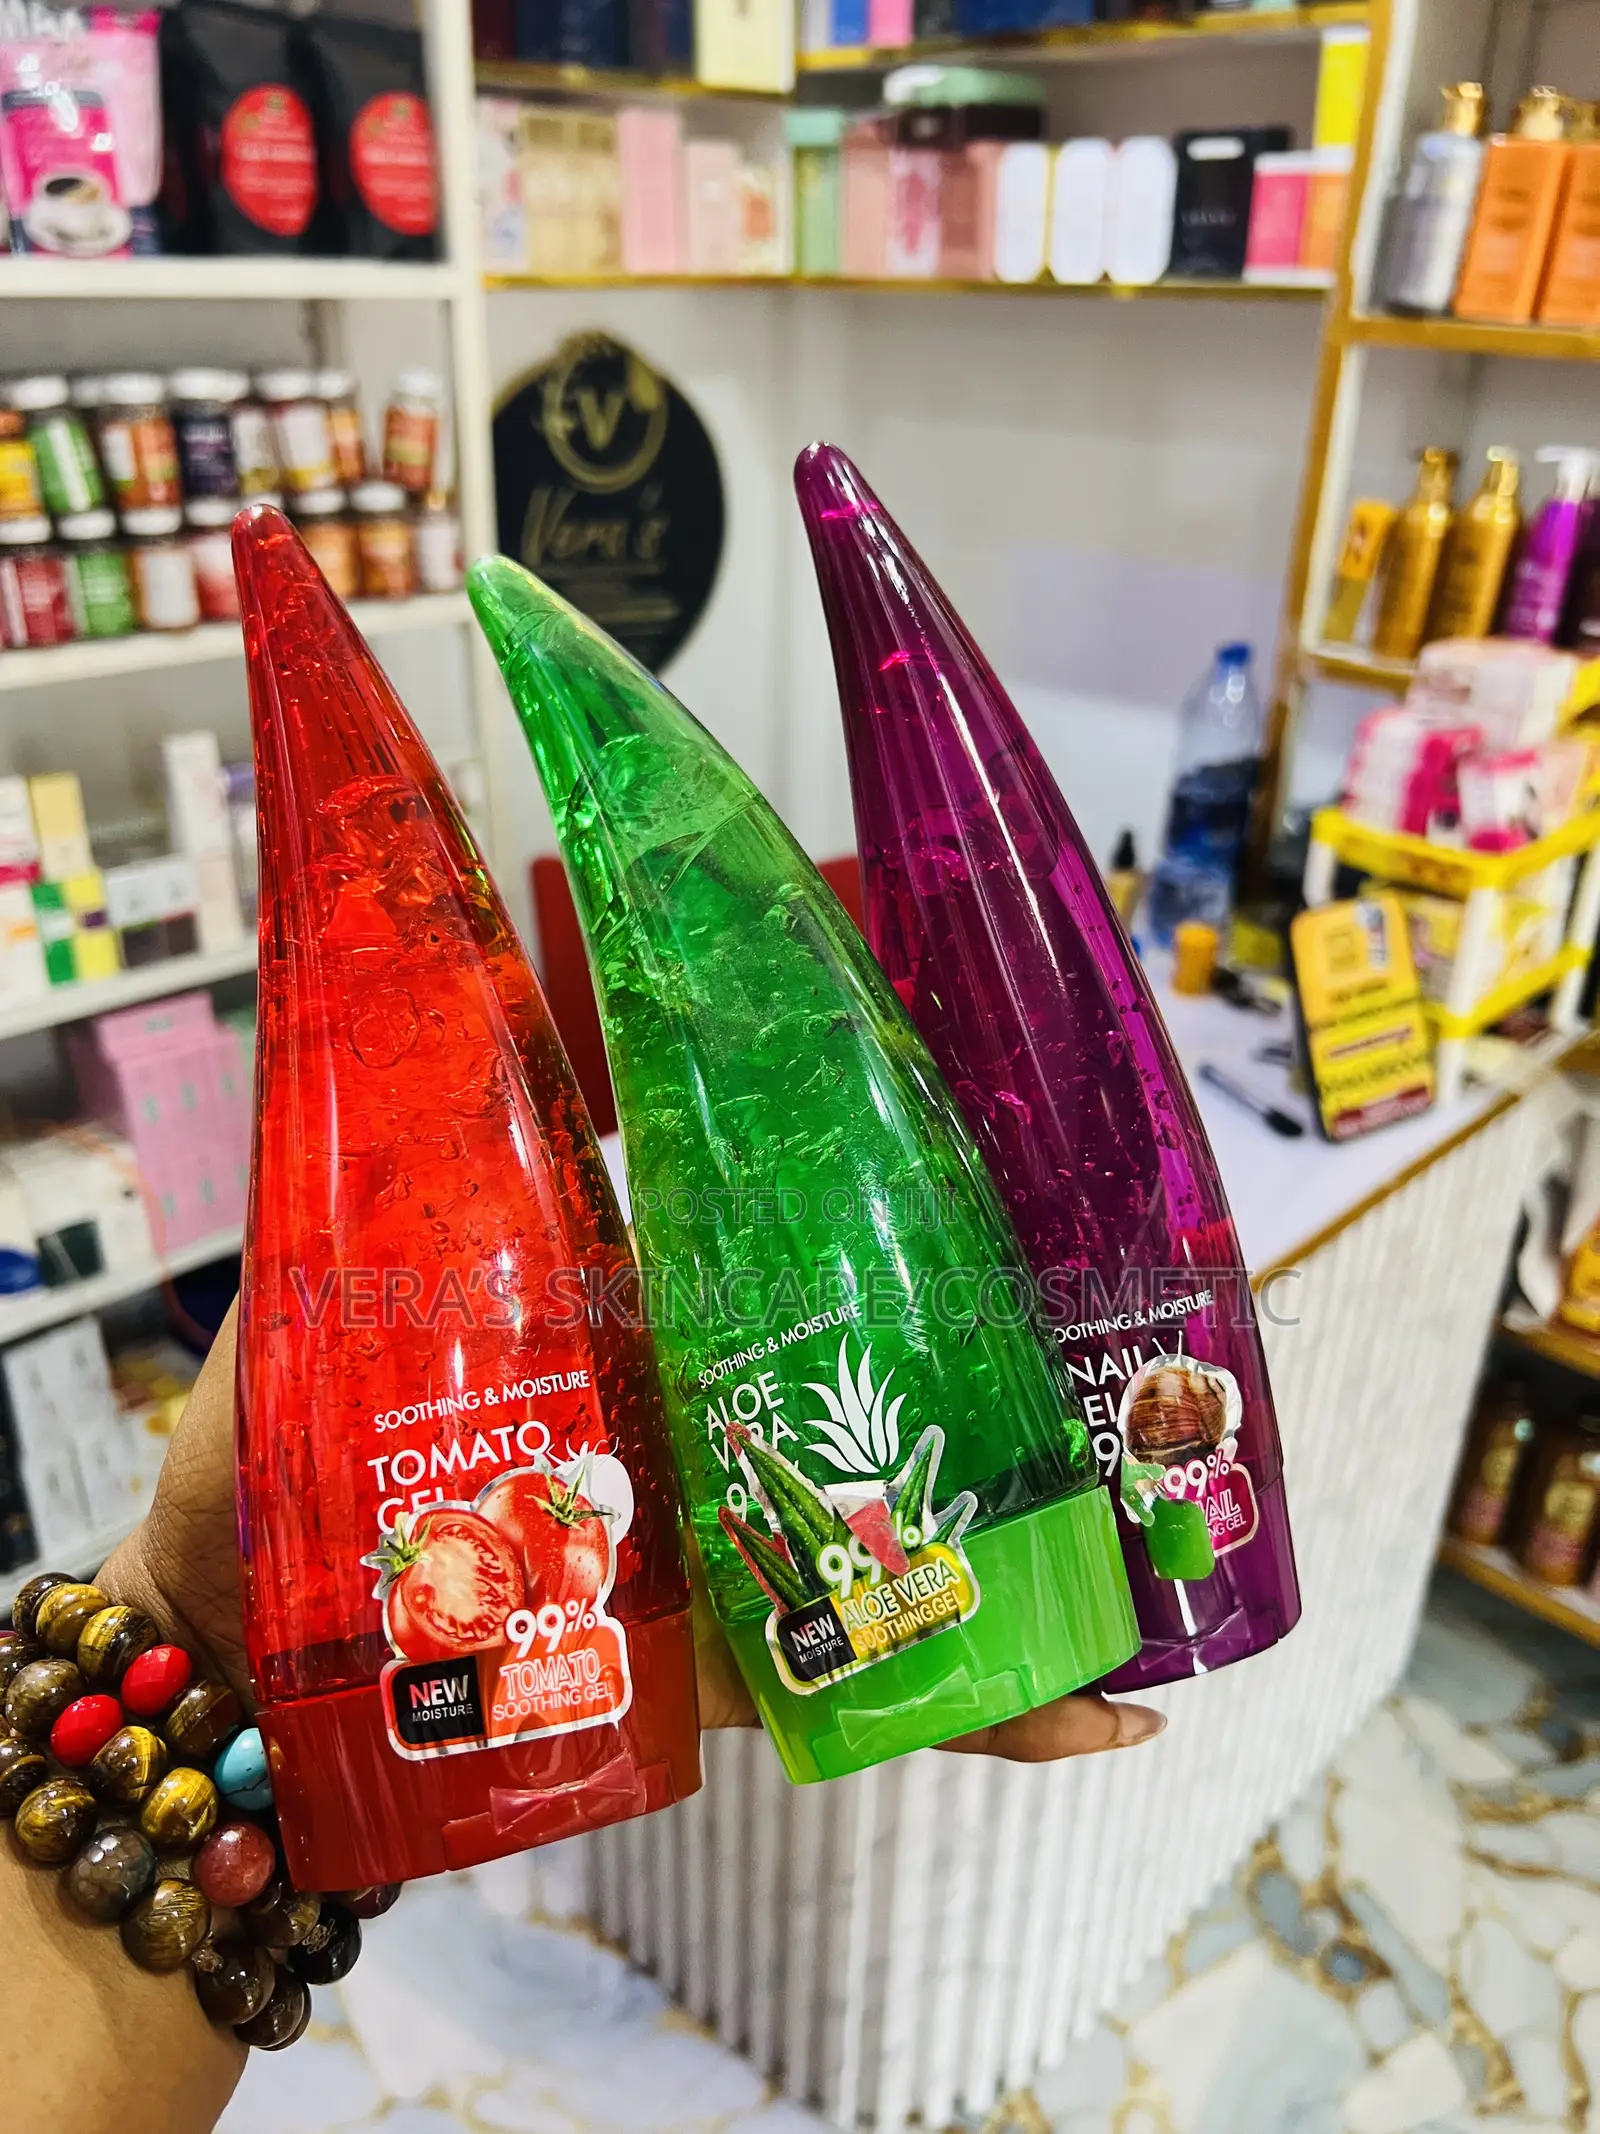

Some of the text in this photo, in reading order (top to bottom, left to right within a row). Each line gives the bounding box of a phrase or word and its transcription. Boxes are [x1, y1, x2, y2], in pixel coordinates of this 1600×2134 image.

[1054, 1289, 1213, 1343] OOTHING & MOISTURE
[698, 1302, 862, 1389] SOOTHING & MOISTURE
[374, 1370, 591, 1433] SOOTHING & MOISTURE
[706, 1370, 785, 1441] ALOE
[367, 1420, 550, 1492] TOMATO
[1163, 1451, 1230, 1500] 99%
[1226, 1512, 1247, 1531] GEL
[840, 1556, 961, 1630] ALOE VERA
[505, 1598, 597, 1658] 99%
[790, 1613, 836, 1651] NEW
[854, 1589, 964, 1652] SOOTHING GEL
[500, 1648, 601, 1700] TOMATO
[798, 1635, 844, 1664] MOISTURE
[409, 1674, 469, 1709] NEW
[412, 1703, 474, 1722] MOISTURE
[492, 1681, 614, 1721] SOOTHING GEL
